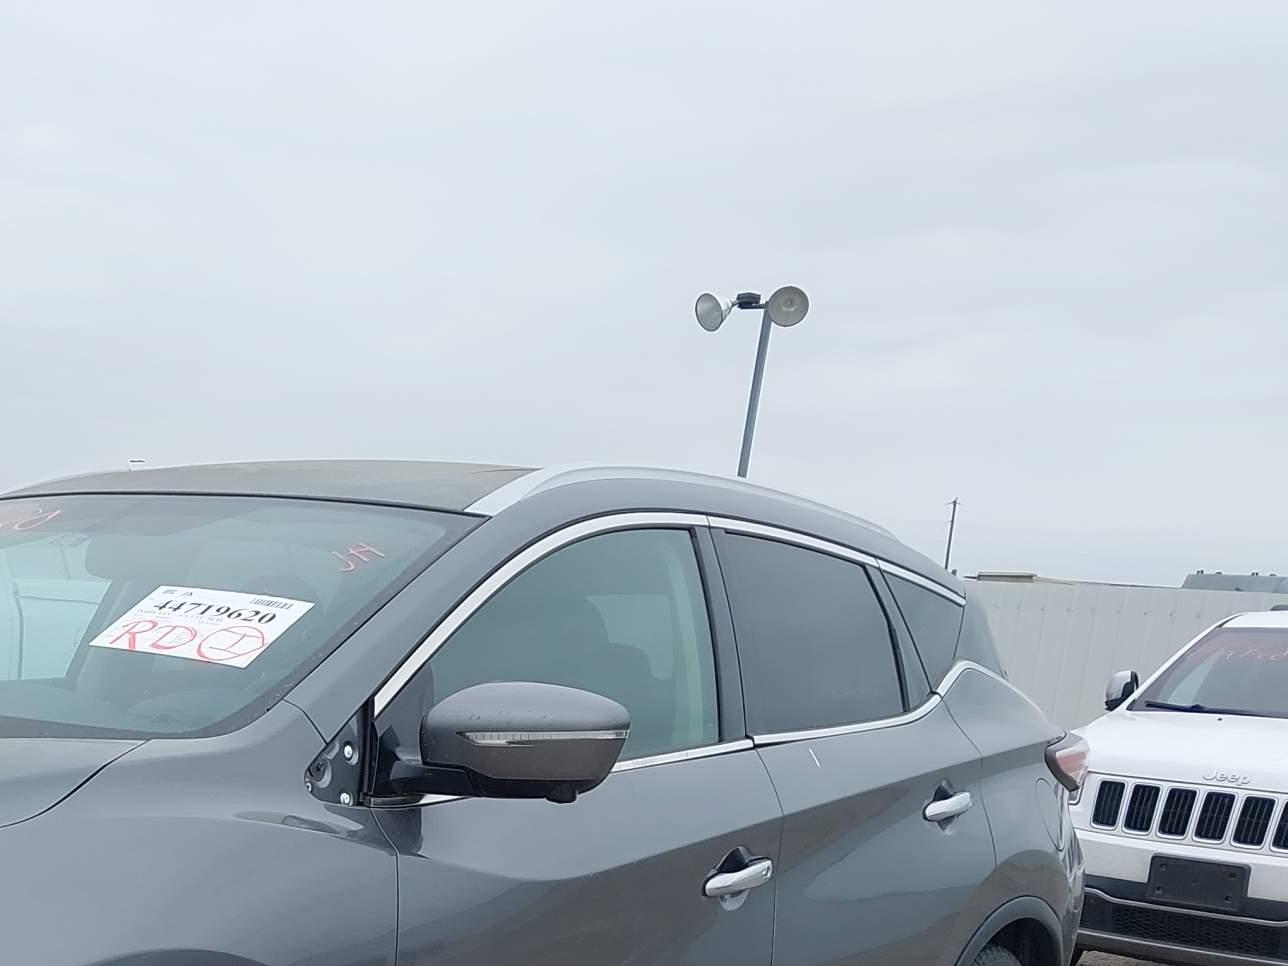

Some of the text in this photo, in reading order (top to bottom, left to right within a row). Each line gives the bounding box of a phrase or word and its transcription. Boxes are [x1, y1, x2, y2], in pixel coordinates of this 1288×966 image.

[153, 599, 277, 625] 44719620
[109, 619, 198, 651] RD
[1202, 767, 1251, 787] Jeep
